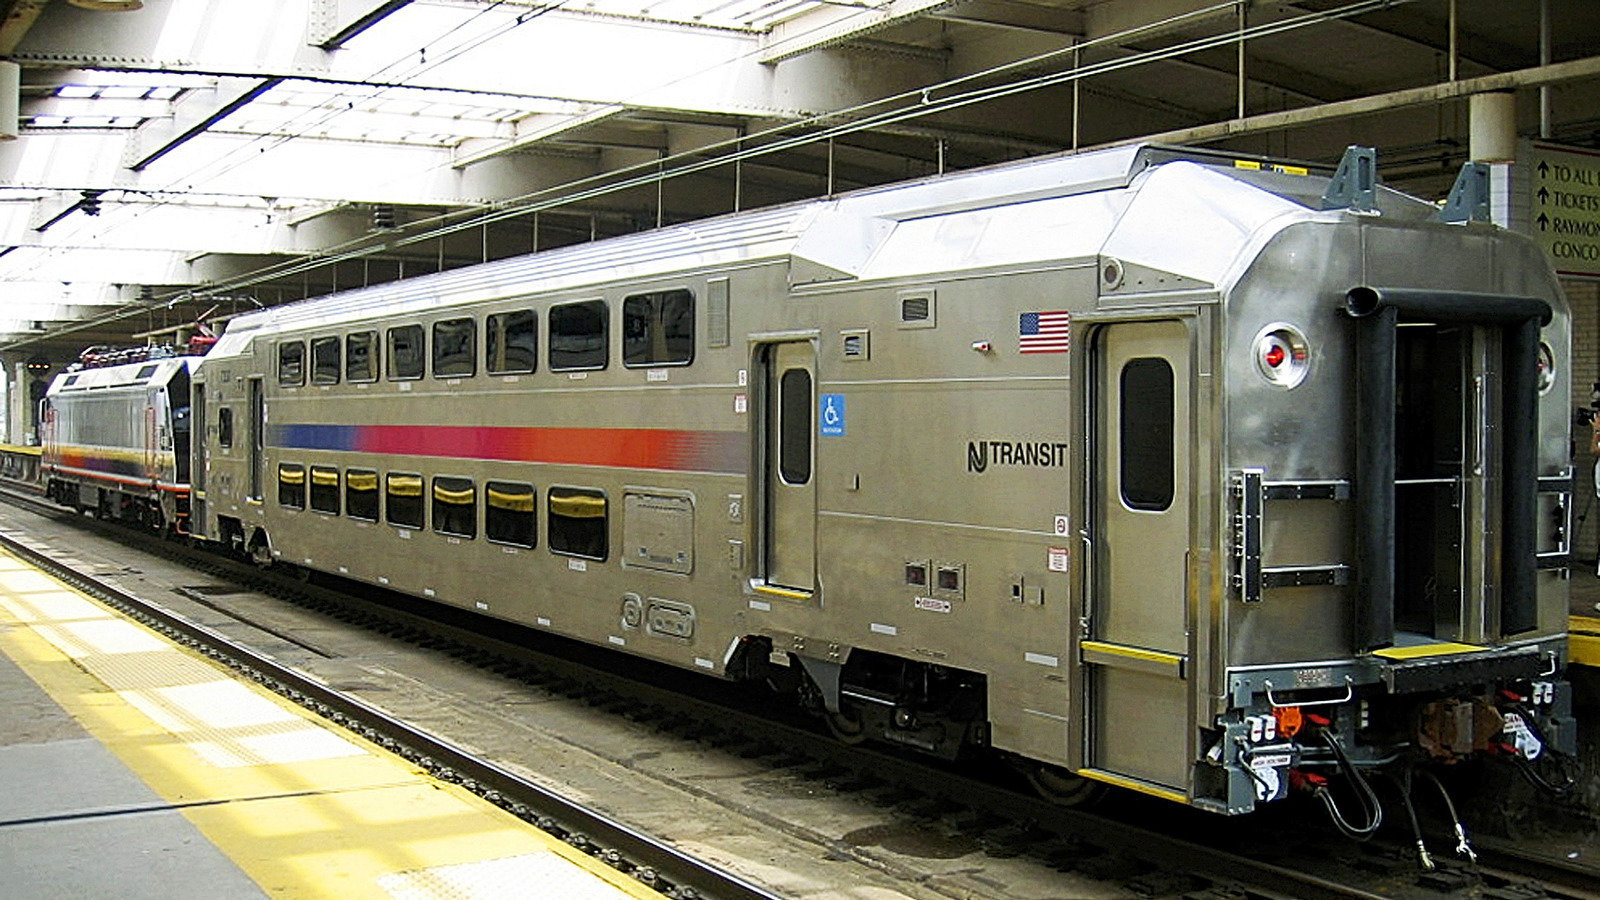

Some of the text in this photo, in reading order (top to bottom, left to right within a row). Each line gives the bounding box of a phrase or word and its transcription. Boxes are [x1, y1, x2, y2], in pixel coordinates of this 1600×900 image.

[1553, 165, 1571, 182] TO
[1573, 169, 1594, 186] ALL
[1553, 191, 1599, 212] TICKETS
[990, 441, 1068, 467] TRANSIT
